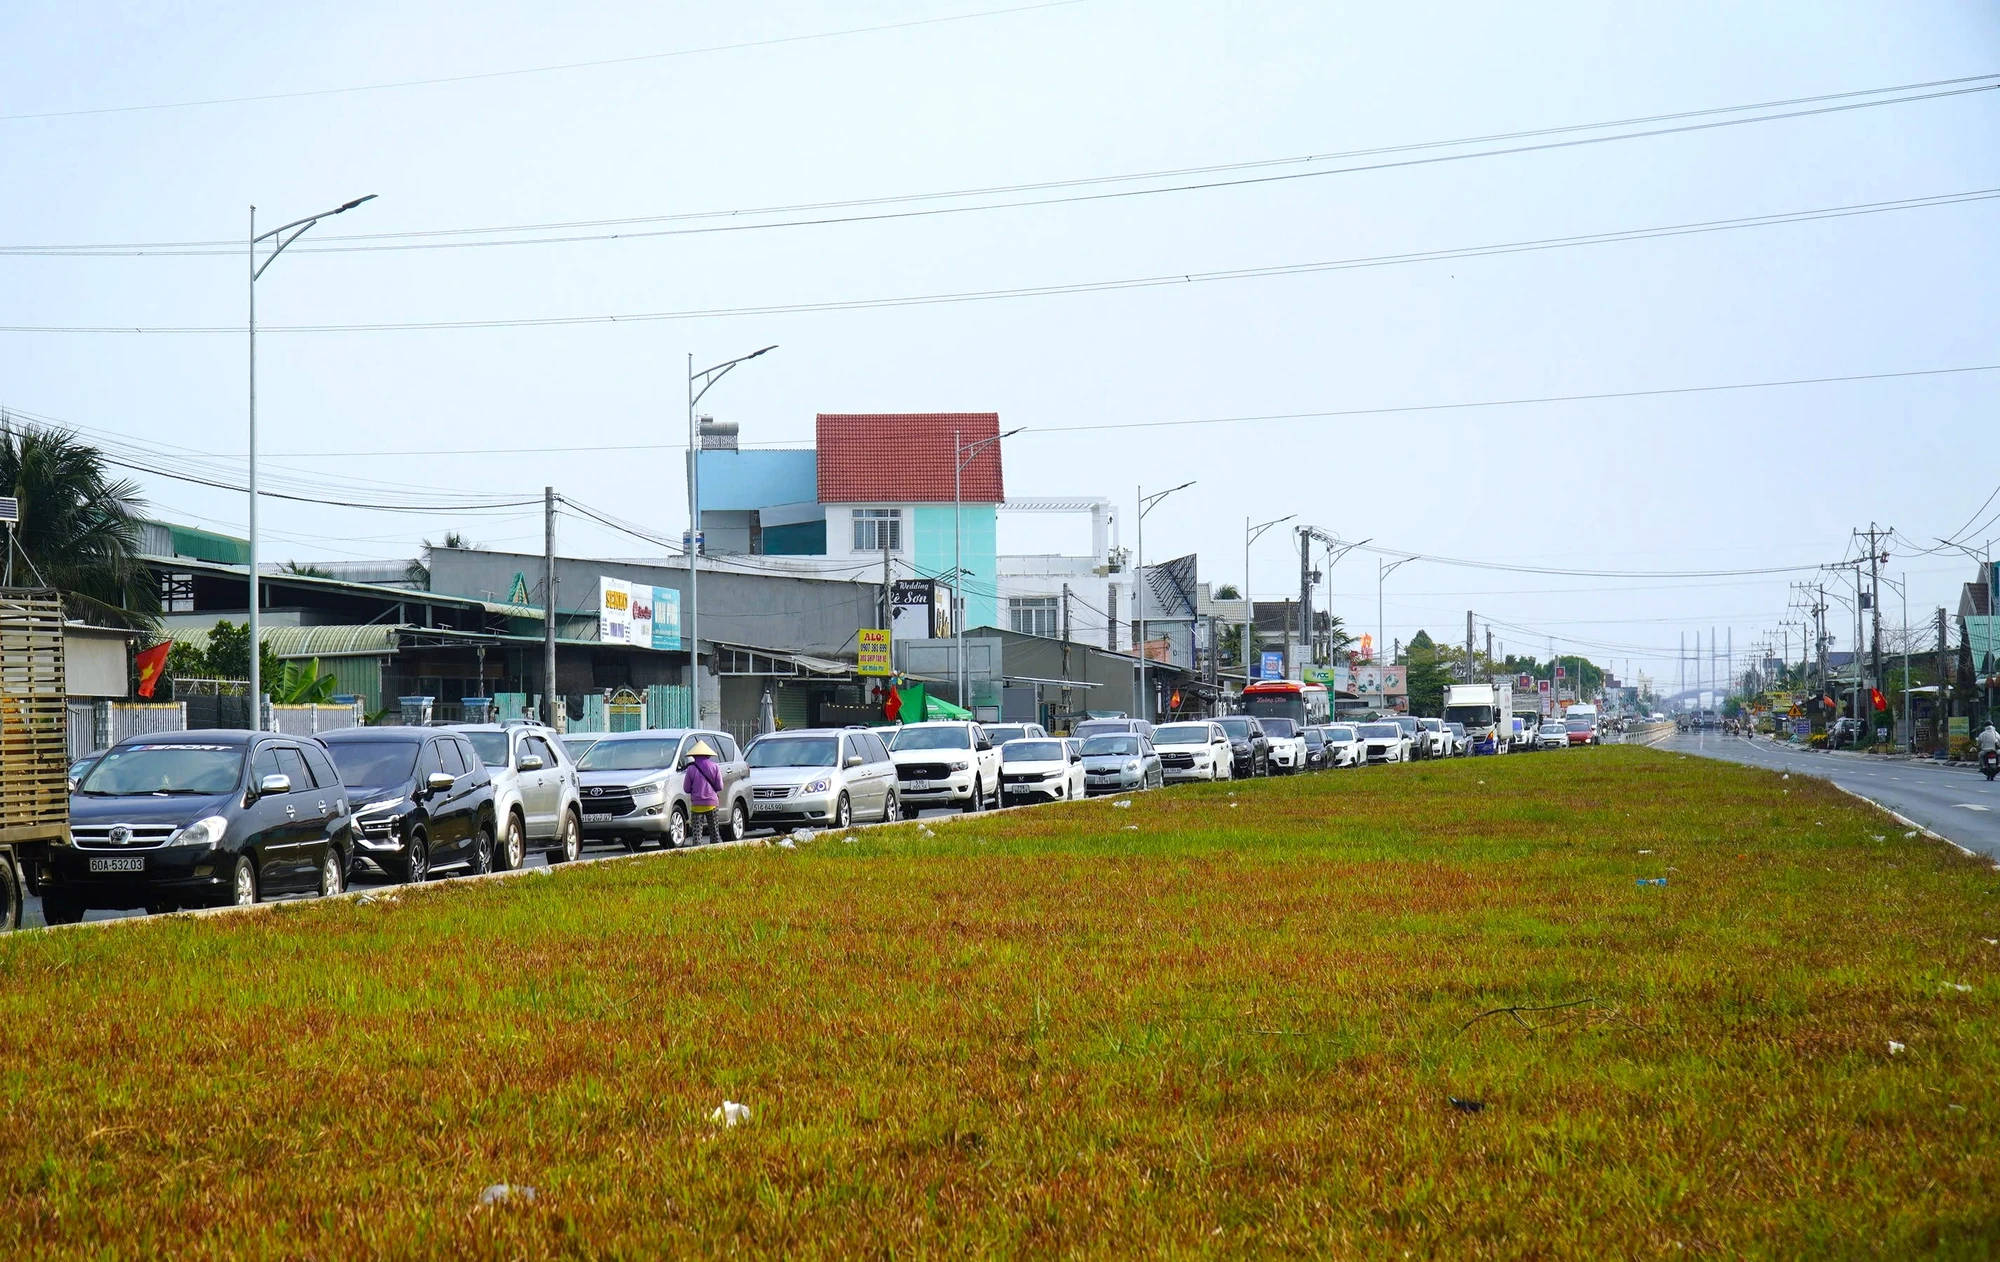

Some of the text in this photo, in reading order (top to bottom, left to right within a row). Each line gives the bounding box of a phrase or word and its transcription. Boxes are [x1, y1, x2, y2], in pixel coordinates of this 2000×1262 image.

[900, 582, 929, 590] Wedding
[904, 591, 927, 603] Sơn
[864, 633, 885, 641] ALO:
